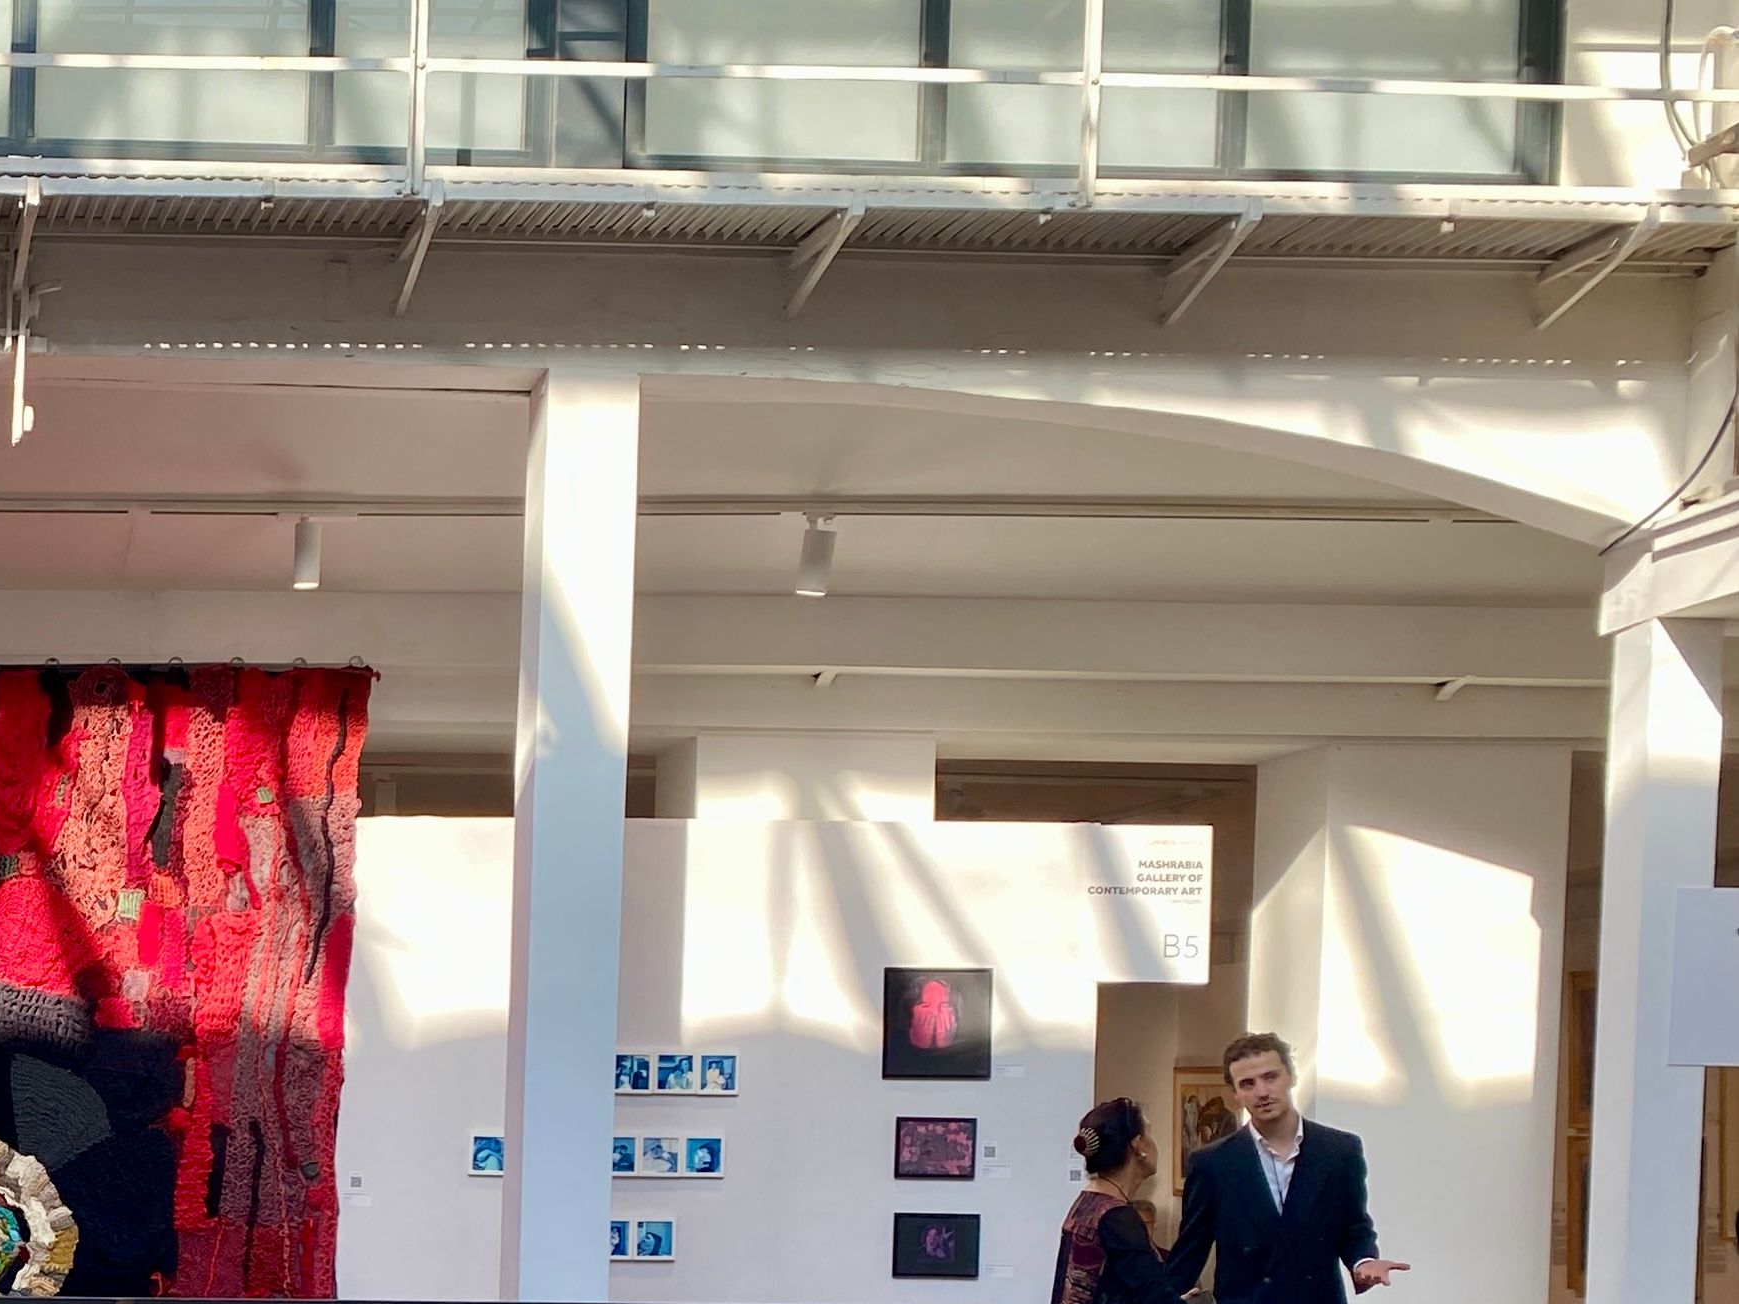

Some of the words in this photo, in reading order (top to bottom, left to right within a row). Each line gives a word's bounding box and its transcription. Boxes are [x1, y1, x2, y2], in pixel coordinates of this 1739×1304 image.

[1138, 860, 1204, 870] MASHRABIA
[1136, 874, 1186, 883] GALLERY
[1187, 874, 1203, 883] OF
[1087, 886, 1179, 896] CONTEMPORARY
[1180, 887, 1203, 896] ART
[1163, 934, 1199, 958] B5
